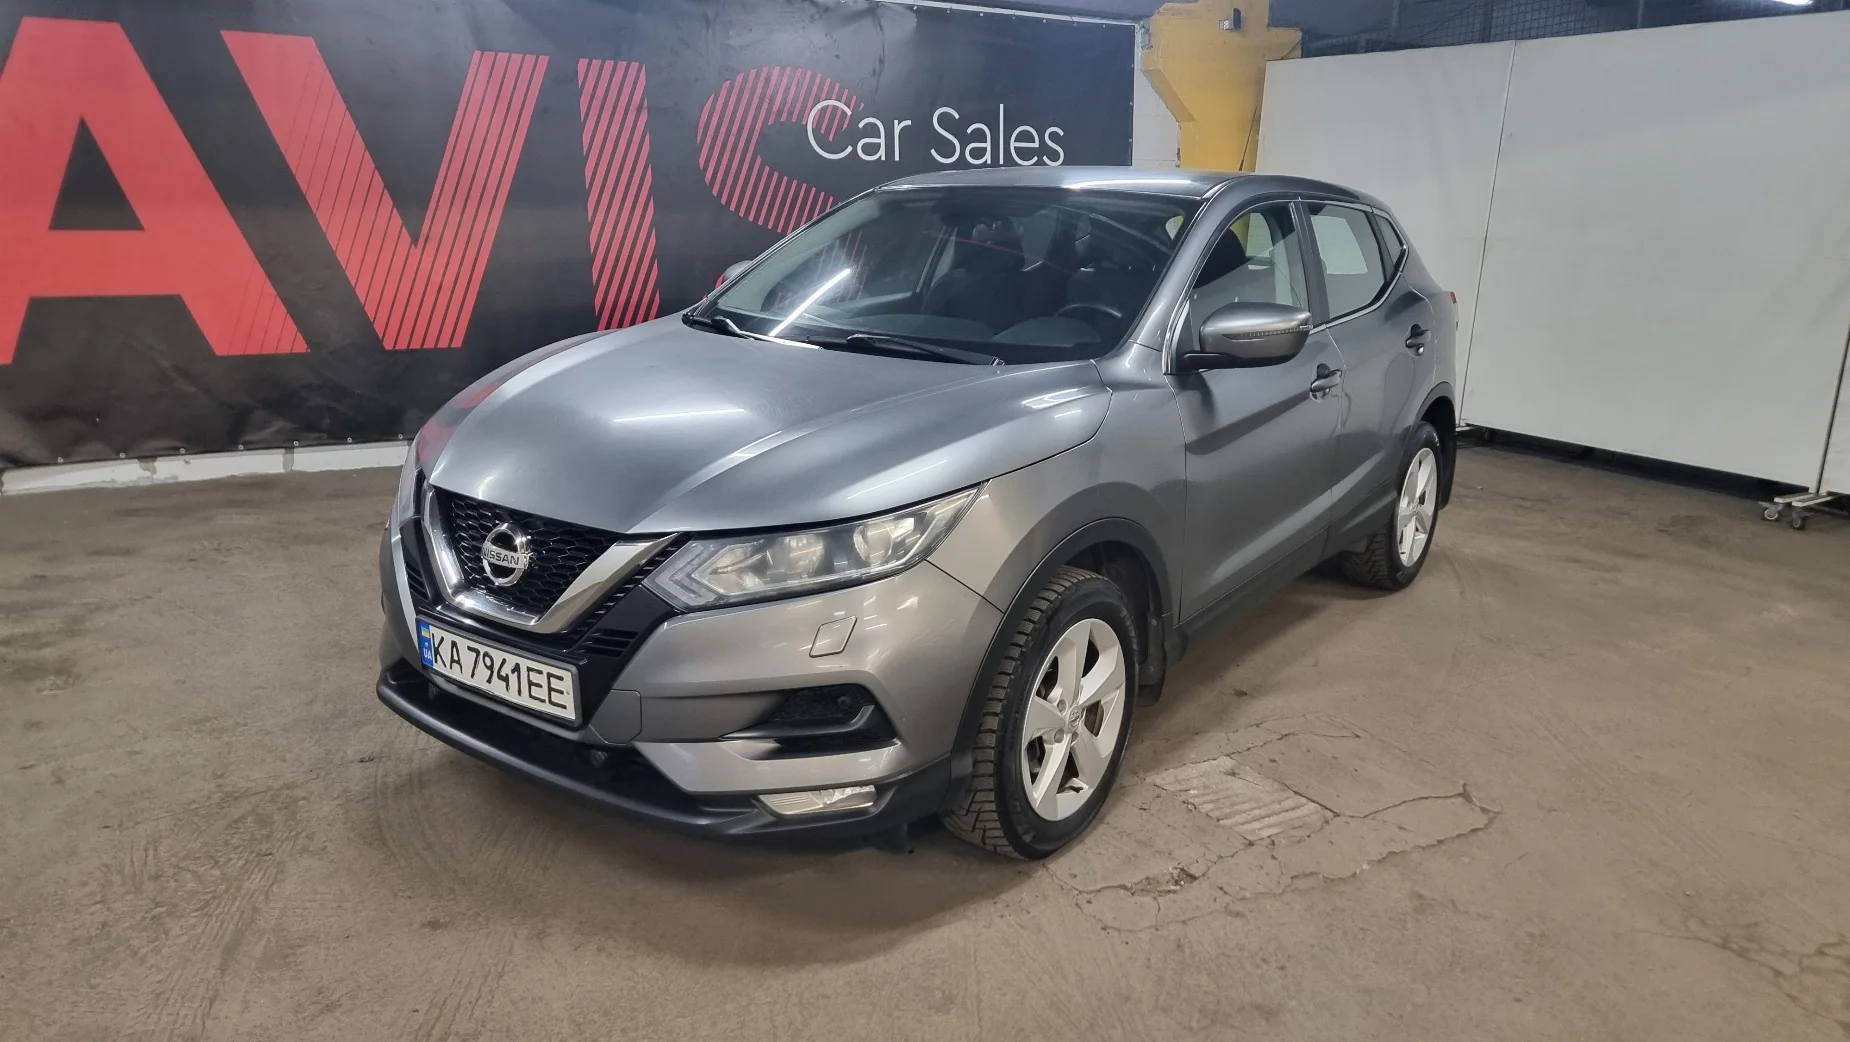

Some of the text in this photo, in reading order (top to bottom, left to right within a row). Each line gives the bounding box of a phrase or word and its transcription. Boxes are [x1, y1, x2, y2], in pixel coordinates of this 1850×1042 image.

[807, 100, 1064, 166] Car Sales
[483, 546, 519, 566] NISSAN
[423, 648, 432, 660] UA
